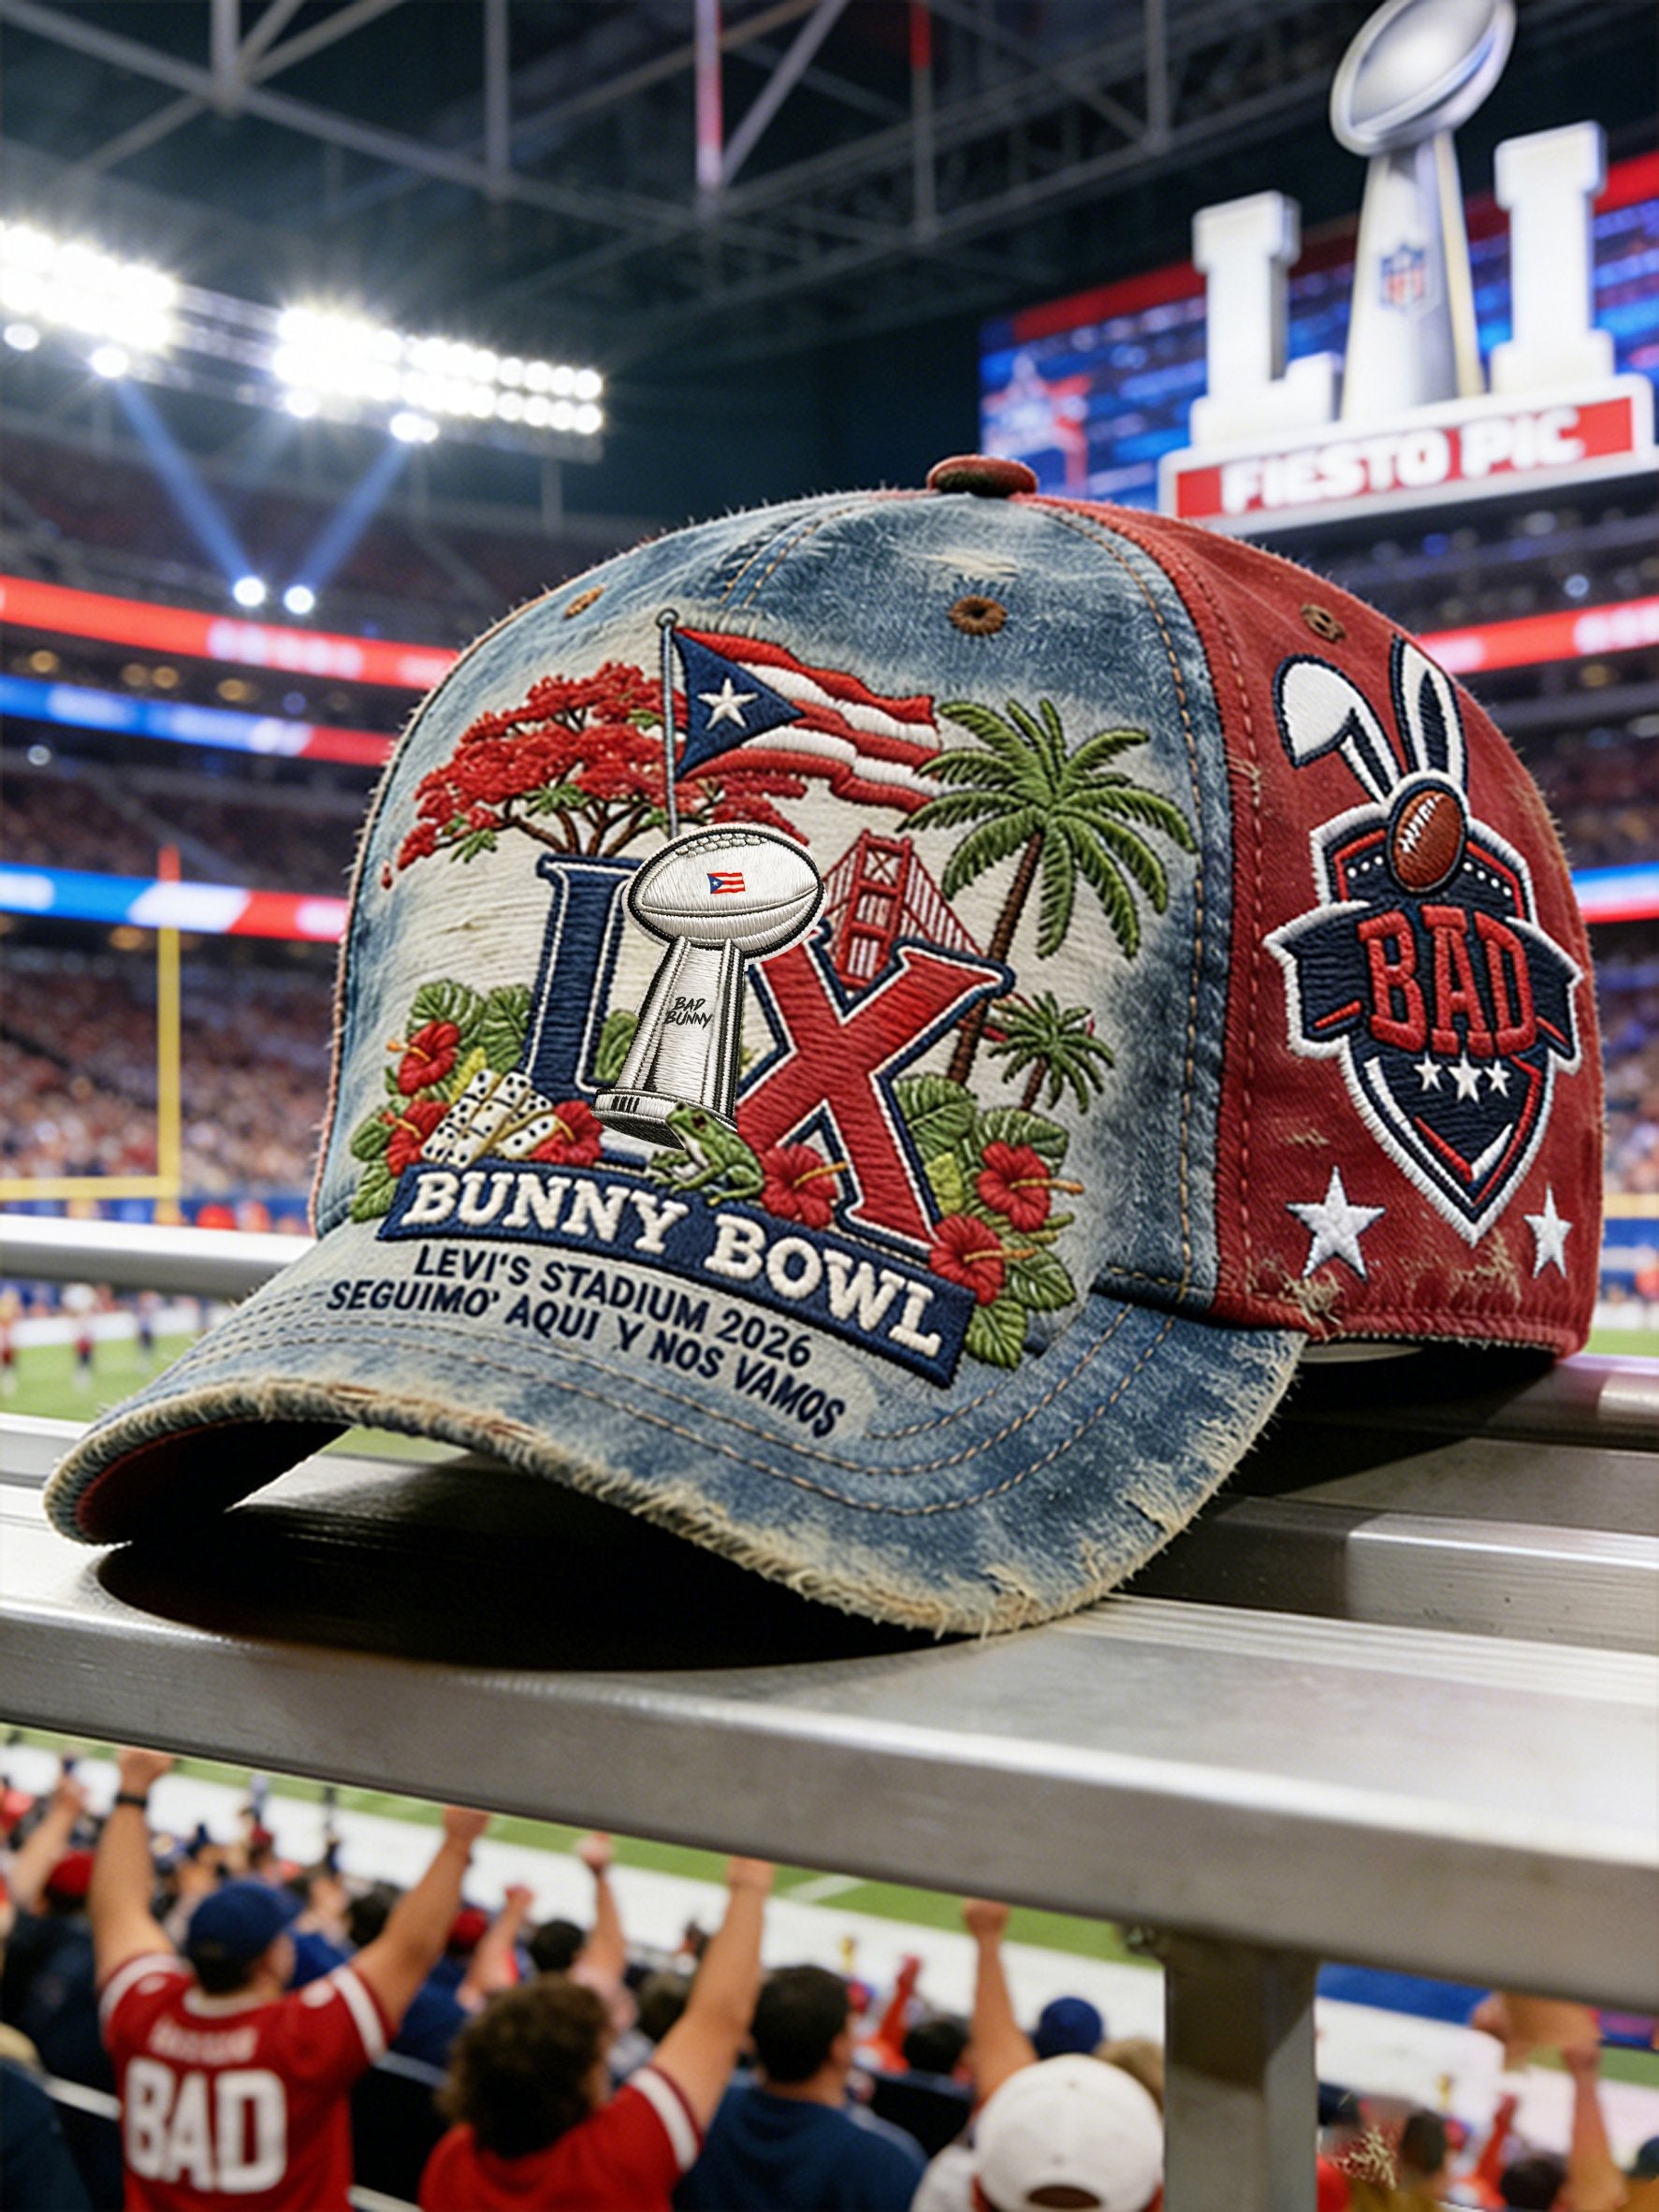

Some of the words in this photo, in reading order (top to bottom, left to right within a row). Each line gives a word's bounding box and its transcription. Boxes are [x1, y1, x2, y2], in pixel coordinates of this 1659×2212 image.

[1220, 428, 1450, 516] FIESTO
[1460, 406, 1586, 478] PIC
[663, 1011, 713, 1030] BUNNY
[672, 996, 706, 1011] BAD
[1358, 904, 1537, 1057] BAD
[400, 1171, 689, 1255] BUNNY
[705, 1213, 942, 1358] BOWL
[414, 1244, 531, 1287] LEVI'S
[539, 1261, 710, 1333] STADIUM
[716, 1309, 811, 1369] 2026
[327, 1279, 501, 1318] SEGUIMO'
[503, 1293, 602, 1340] AQUI
[617, 1314, 645, 1352] Y
[648, 1329, 725, 1379] NOS
[734, 1354, 846, 1438] VAMOS
[125, 2055, 287, 2194] BAD
